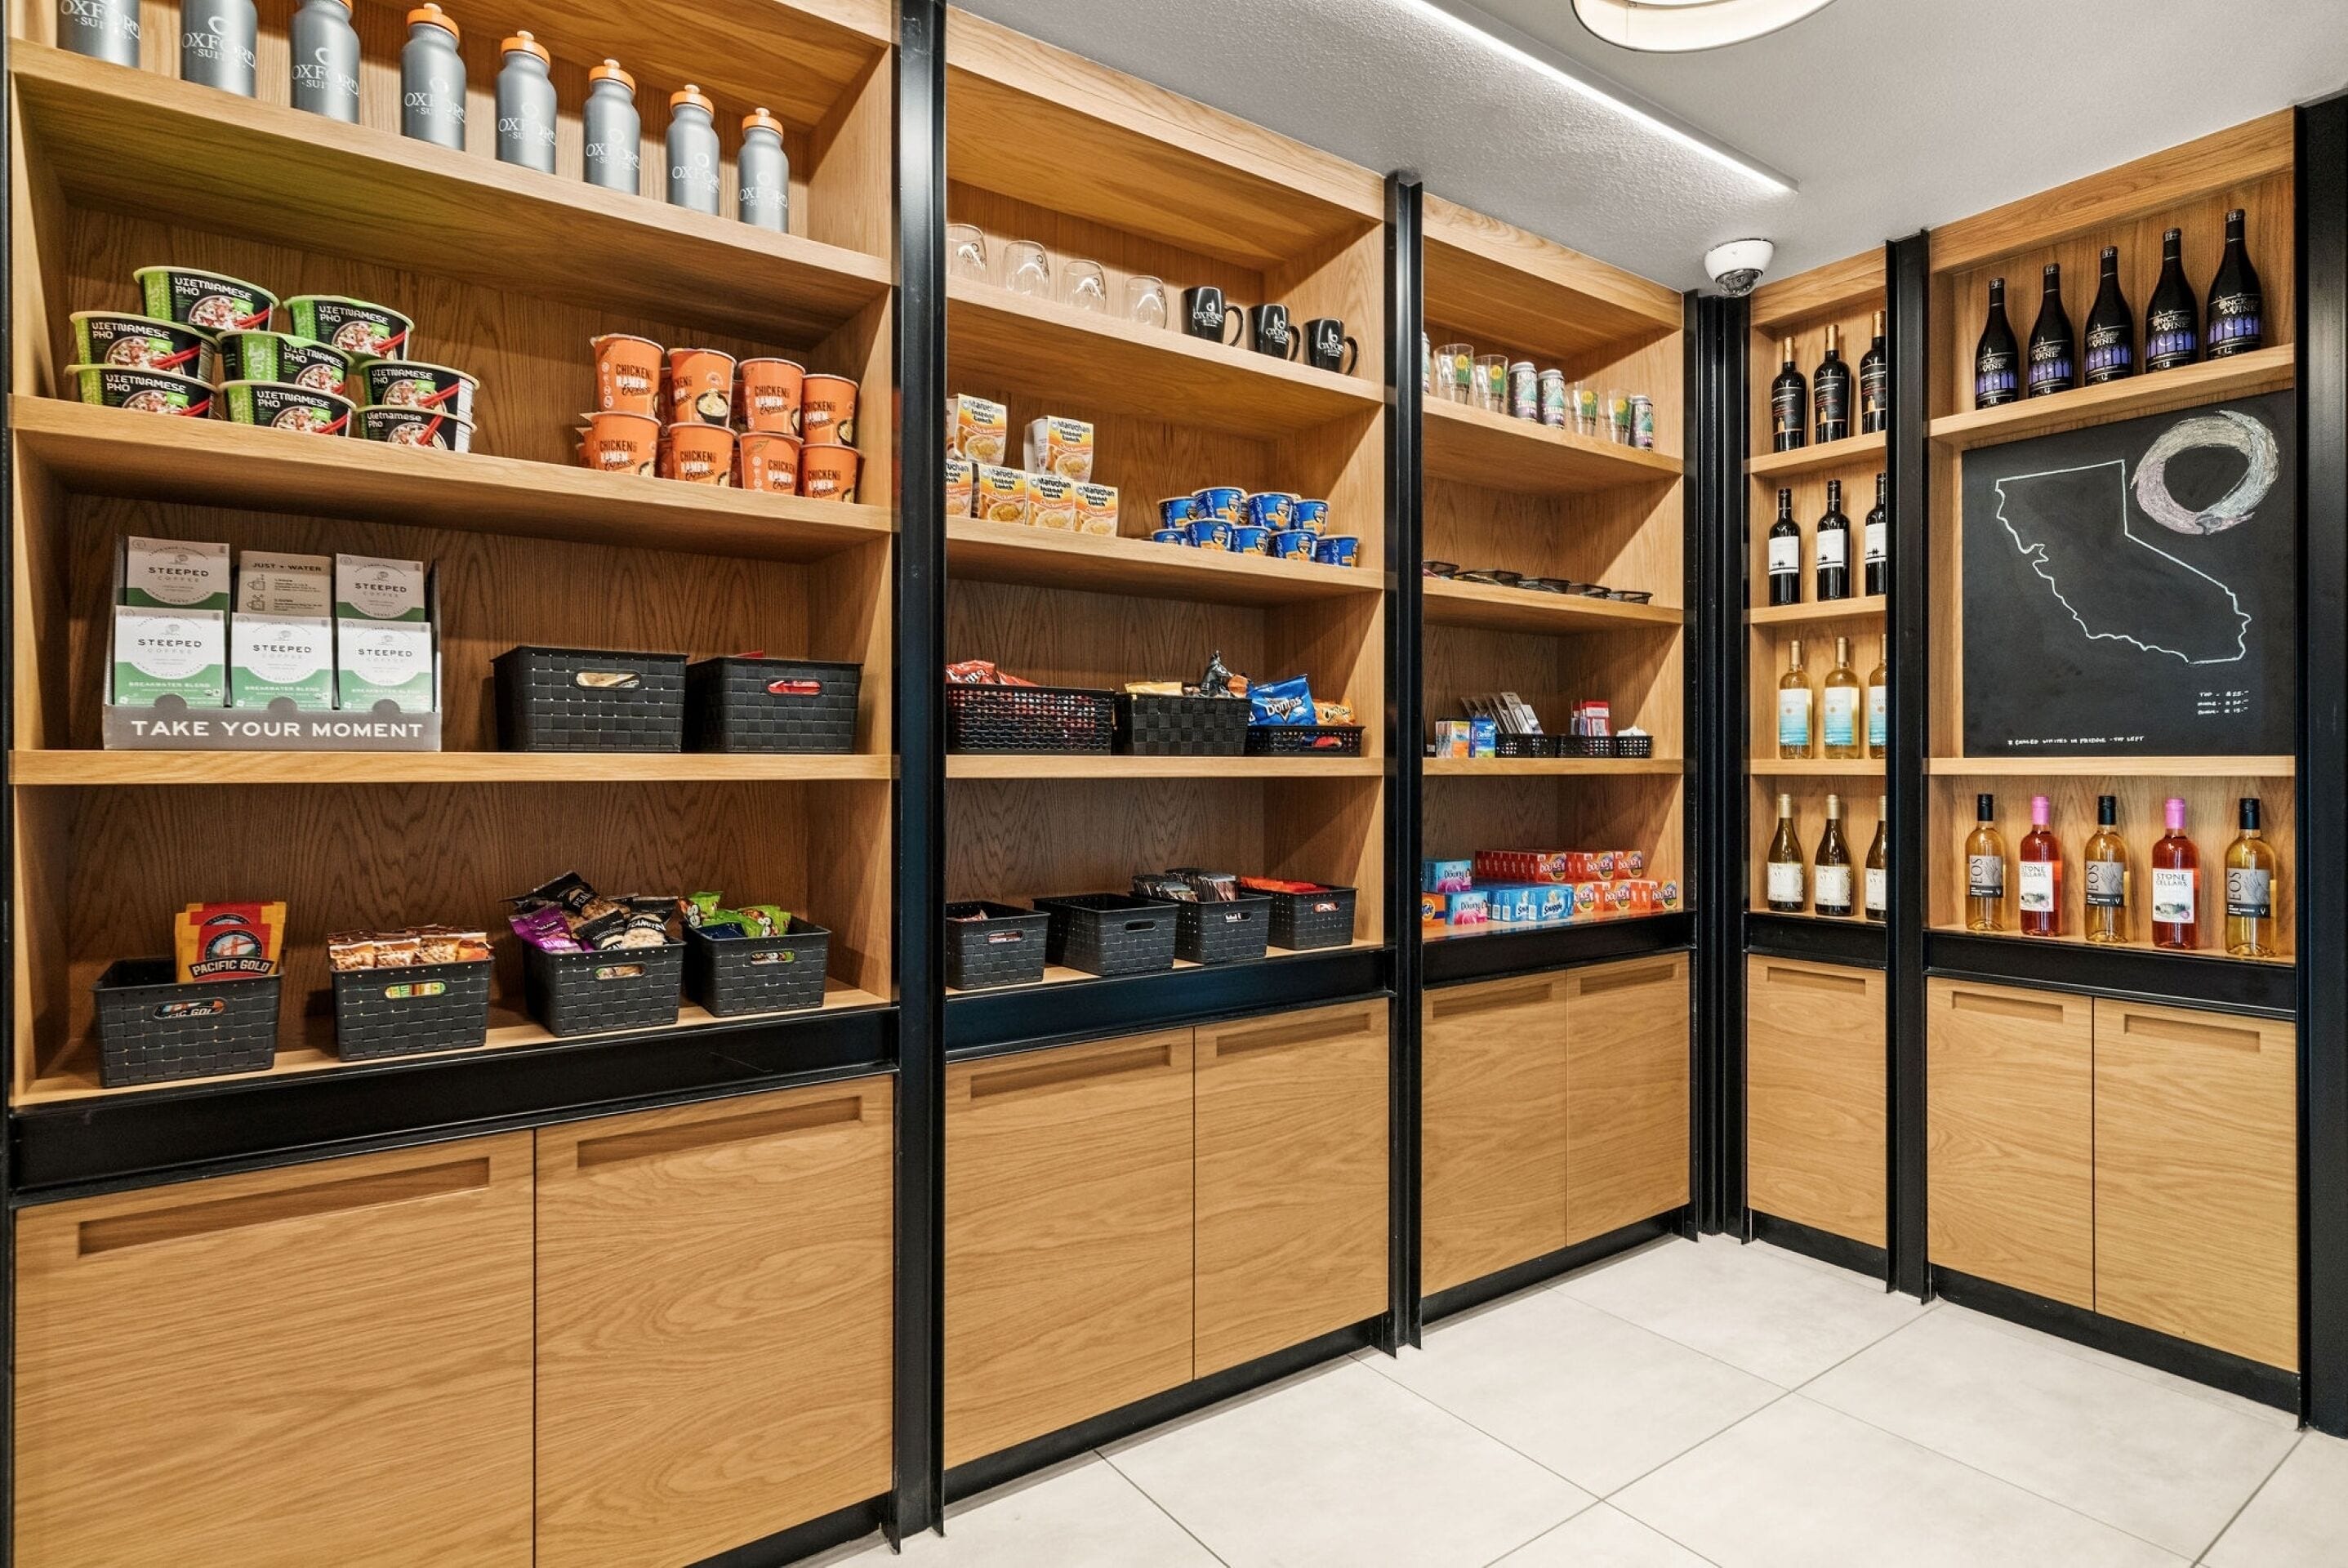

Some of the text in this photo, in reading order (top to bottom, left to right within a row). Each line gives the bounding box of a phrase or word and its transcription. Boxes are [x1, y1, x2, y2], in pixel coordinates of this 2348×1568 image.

[60, 0, 140, 40] OXFRD
[174, 277, 253, 301] VIETNAMESE
[175, 285, 200, 296] PHO
[319, 305, 390, 326] VIETNAMESE
[319, 314, 341, 323] PHO
[91, 321, 171, 340] VIETNAMESE
[92, 330, 114, 340] PHO
[372, 369, 434, 381] VIETNAMESE
[372, 376, 389, 385] PHO
[106, 374, 186, 394] VIETNAMESE
[106, 382, 131, 393] PHO
[256, 390, 331, 409] VIETNAMESE
[257, 399, 281, 408] PHO
[149, 566, 210, 577] STEEPED
[354, 582, 407, 593] STEEPED
[138, 639, 203, 648] STEEPED
[252, 644, 312, 653] STEEPED
[358, 648, 412, 657] STEEPED
[1264, 696, 1303, 717] Doritos
[131, 720, 424, 738] TAKE YOUR MOMENT
[1971, 858, 1983, 884] EOS
[2087, 863, 2099, 892] EOS
[2229, 871, 2242, 901] EOS
[192, 960, 270, 976] PACIFIC GOLD
